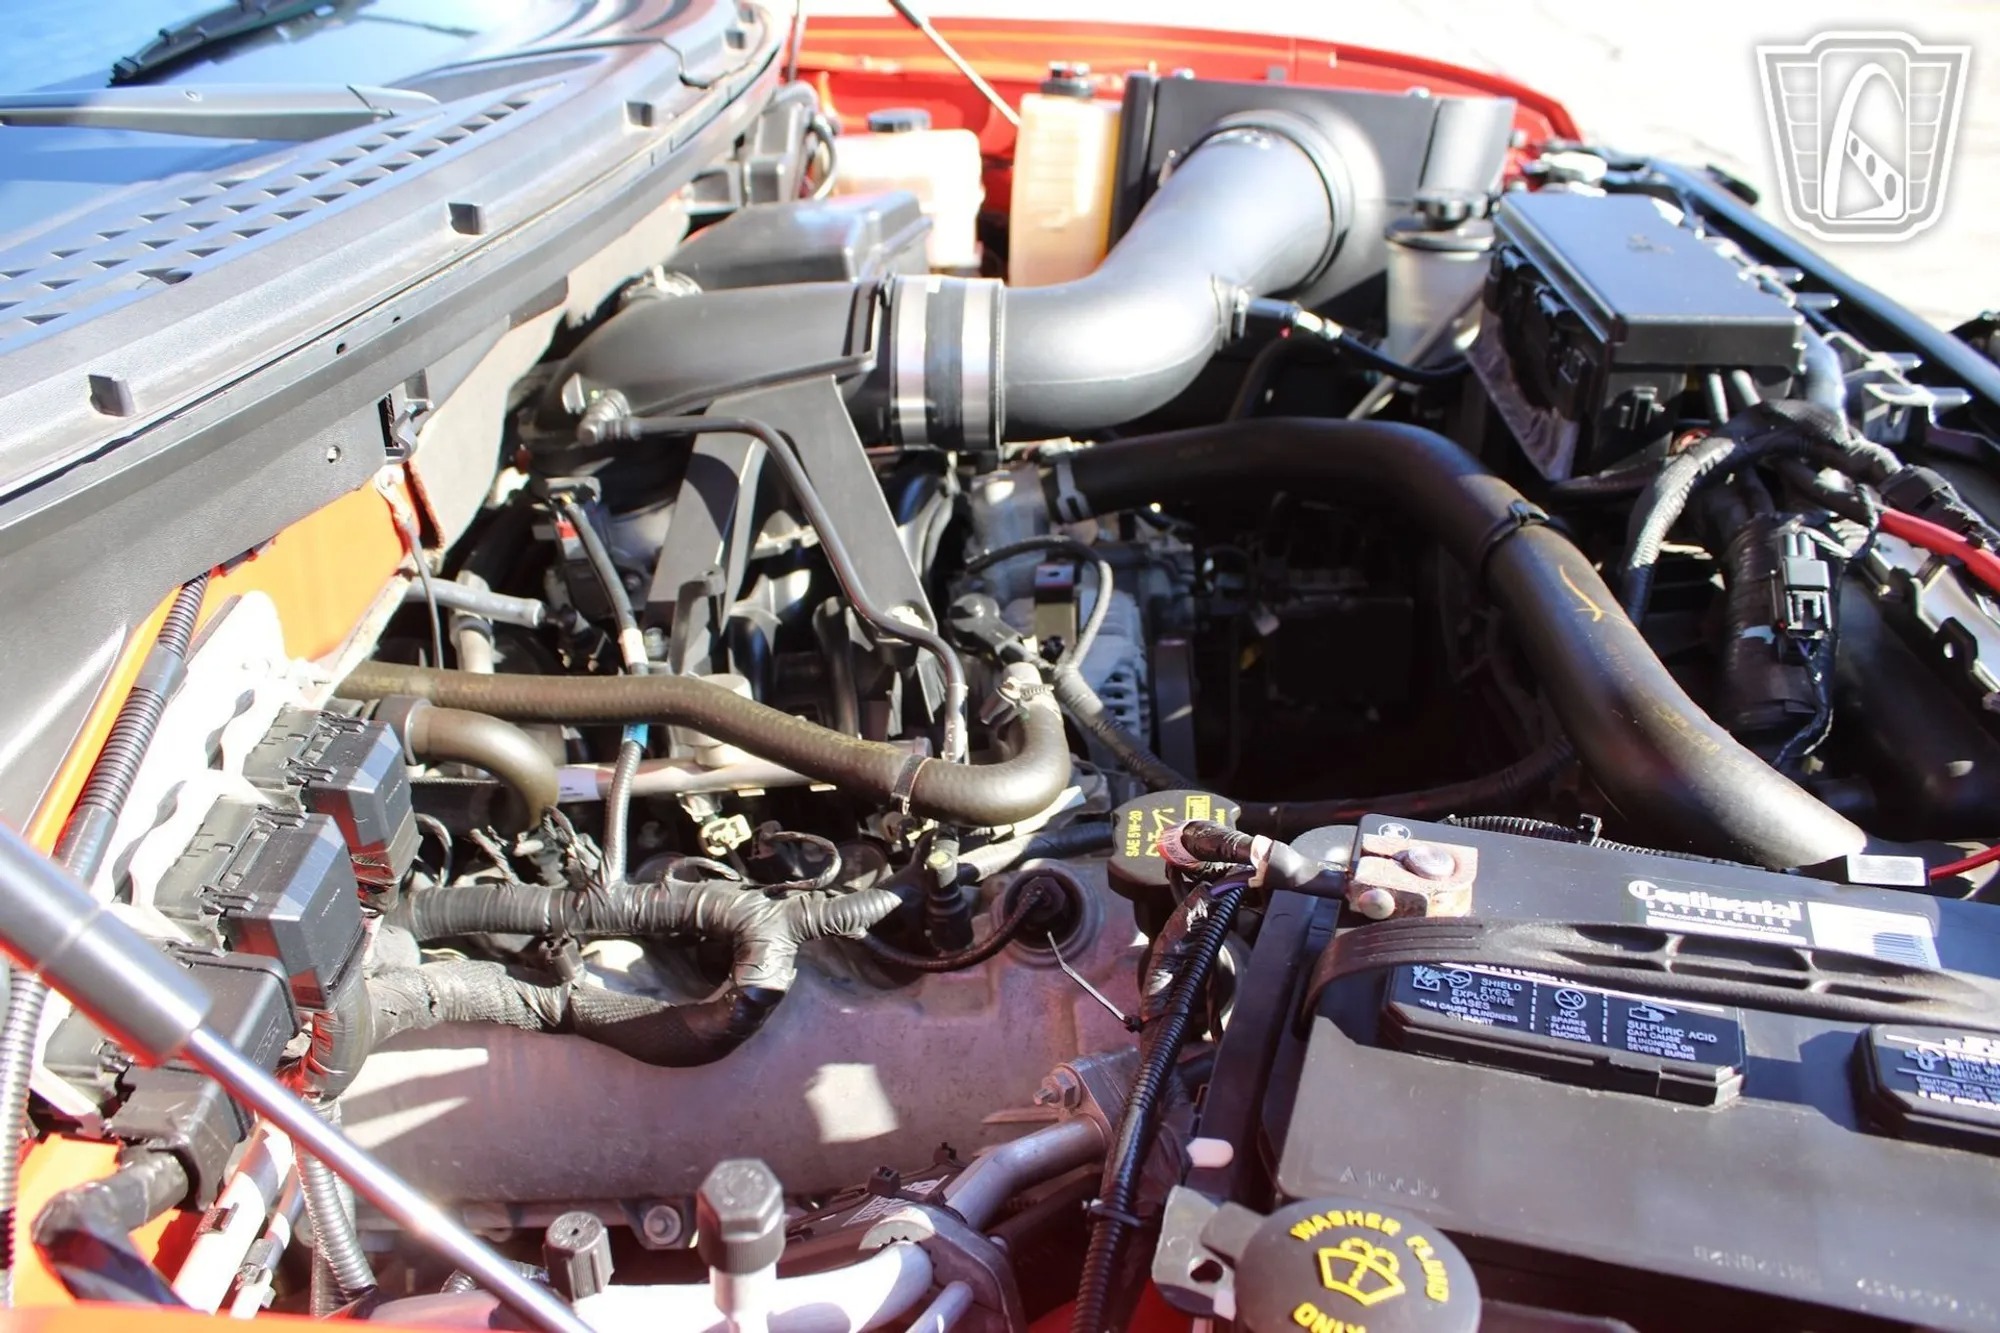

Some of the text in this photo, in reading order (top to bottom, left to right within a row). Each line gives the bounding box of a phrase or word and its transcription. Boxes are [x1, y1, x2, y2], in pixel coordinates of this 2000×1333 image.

[1126, 839, 1141, 857] SAE
[1480, 978, 1522, 992] SHIELD
[1451, 988, 1515, 1007] EXPLOSIVE
[1480, 987, 1511, 998] EYES
[1450, 997, 1491, 1010] GASES
[1439, 1001, 1468, 1014] CAUSE
[1469, 1008, 1519, 1023] BLINDNESS
[1559, 1009, 1579, 1019] NO
[1550, 1022, 1587, 1035] FLAMES
[1551, 1015, 1587, 1028] SPARKS
[1550, 1030, 1592, 1043] SMOKING
[1626, 1029, 1681, 1043] CAN CAUSE
[1627, 1020, 1718, 1043] SULFURIC ACID
[1627, 1036, 1696, 1053] BLINDNESS OR
[1627, 1043, 1696, 1061] SEVERE BURNS
[1289, 1209, 1449, 1304] WASHER FLUID
